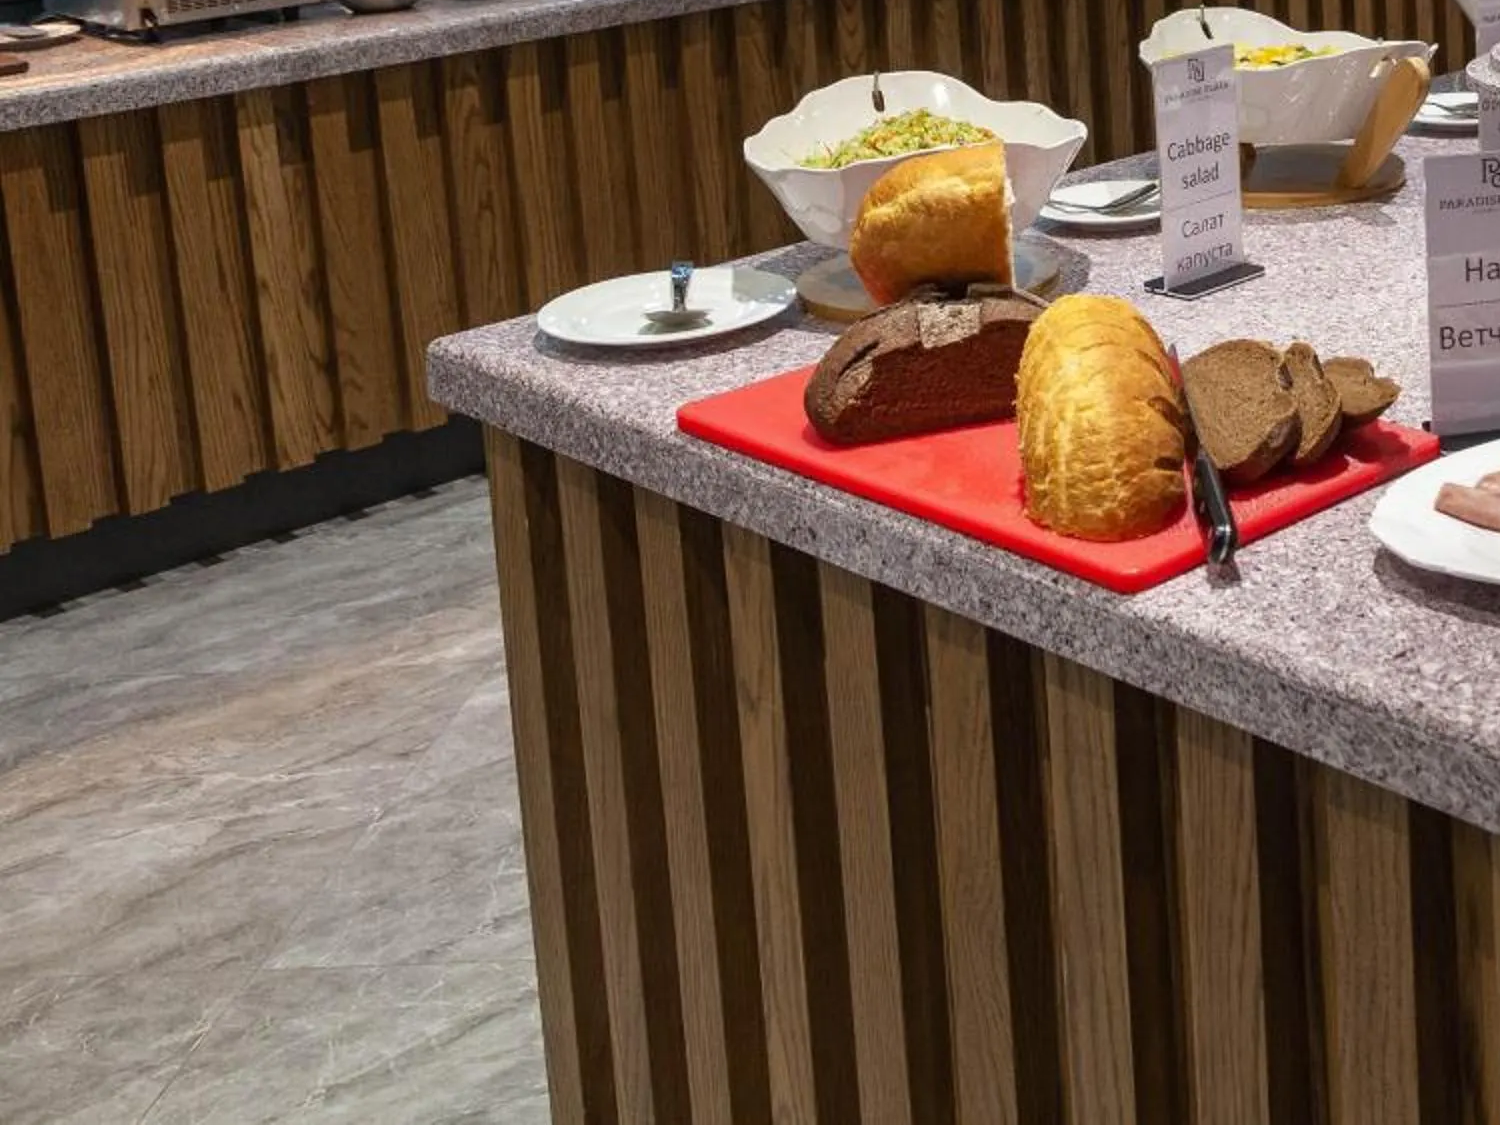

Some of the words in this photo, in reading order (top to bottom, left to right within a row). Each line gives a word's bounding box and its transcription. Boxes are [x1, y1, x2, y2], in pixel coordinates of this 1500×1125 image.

[1167, 132, 1231, 162] Cabbage
[1181, 161, 1219, 189] salad
[1182, 213, 1224, 238] Салат
[1176, 242, 1233, 273] капуста
